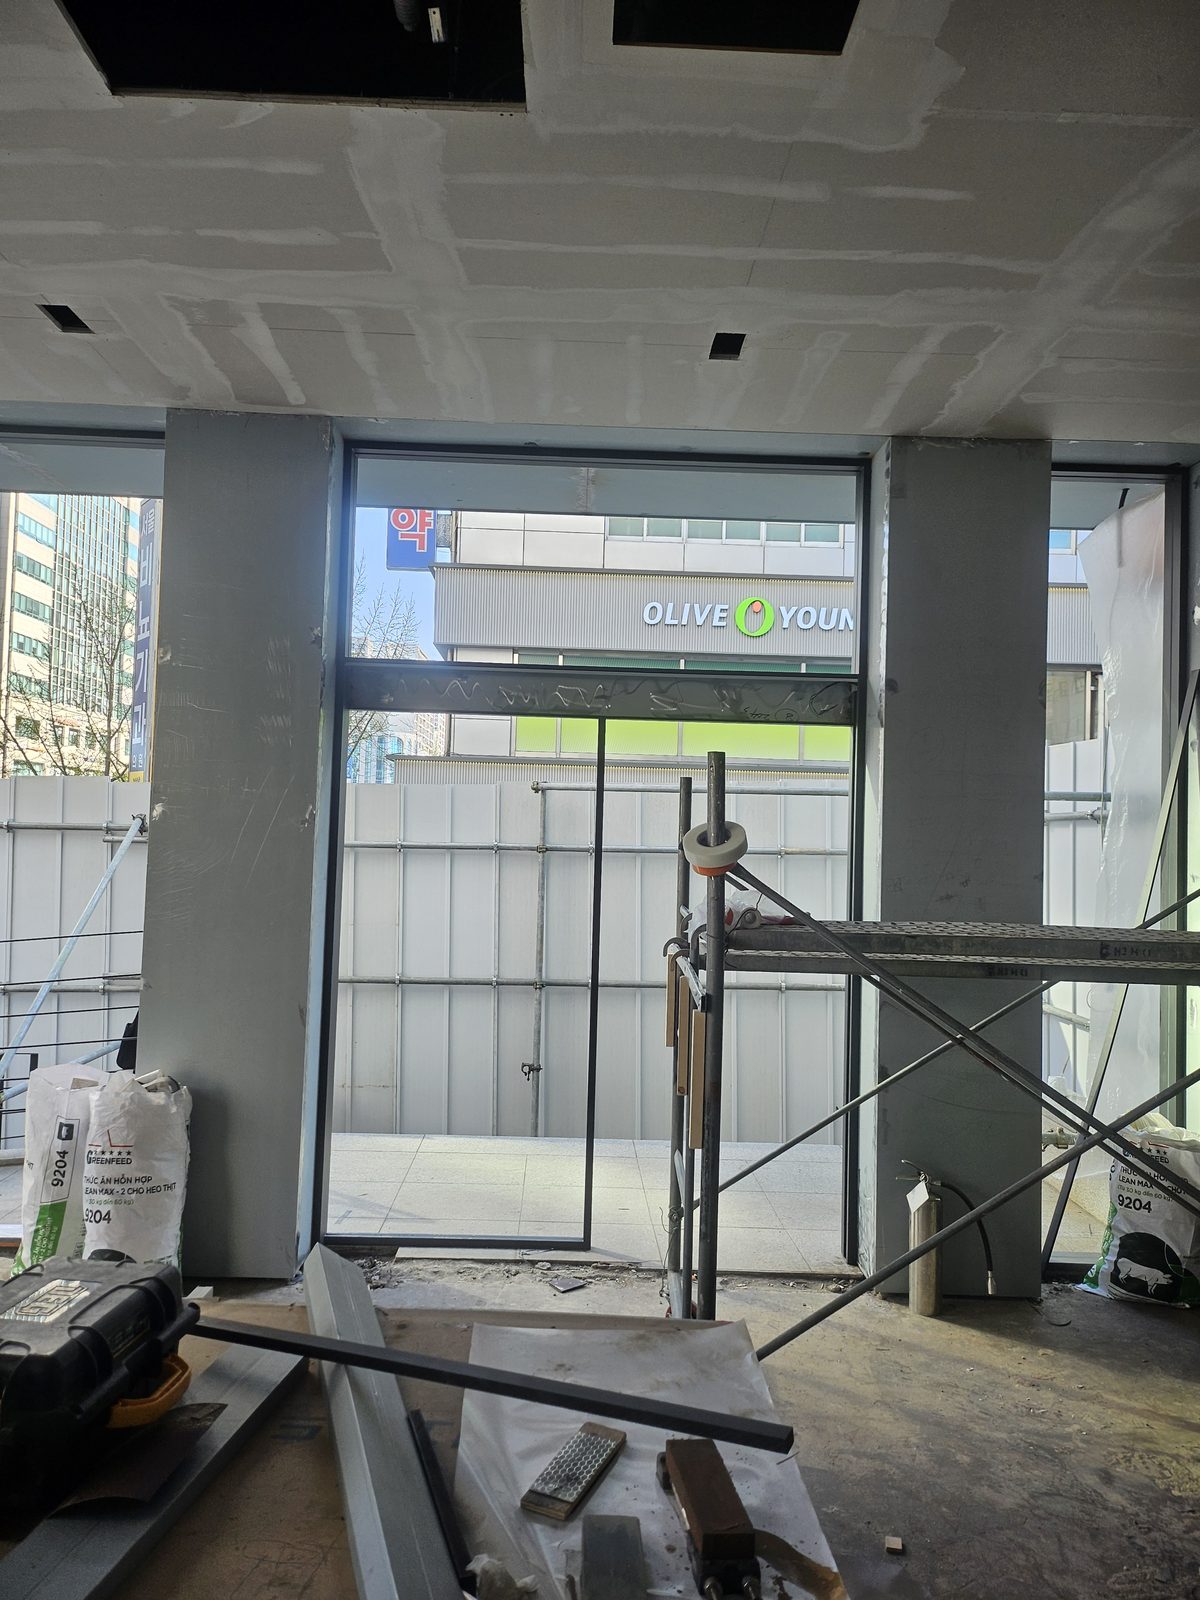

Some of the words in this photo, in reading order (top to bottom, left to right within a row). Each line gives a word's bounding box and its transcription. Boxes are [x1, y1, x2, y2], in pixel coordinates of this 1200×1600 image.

[390, 508, 434, 552] 약
[642, 601, 729, 627] OLIVE
[86, 1149, 132, 1165] GREENFEED
[51, 1150, 69, 1187] 9204
[84, 1187, 97, 1195] EAN
[127, 1187, 145, 1195] CHO
[146, 1184, 162, 1194] HEO
[1119, 1175, 1136, 1186] LEAN
[1117, 1193, 1153, 1214] 9204
[85, 1208, 112, 1225] 9204
